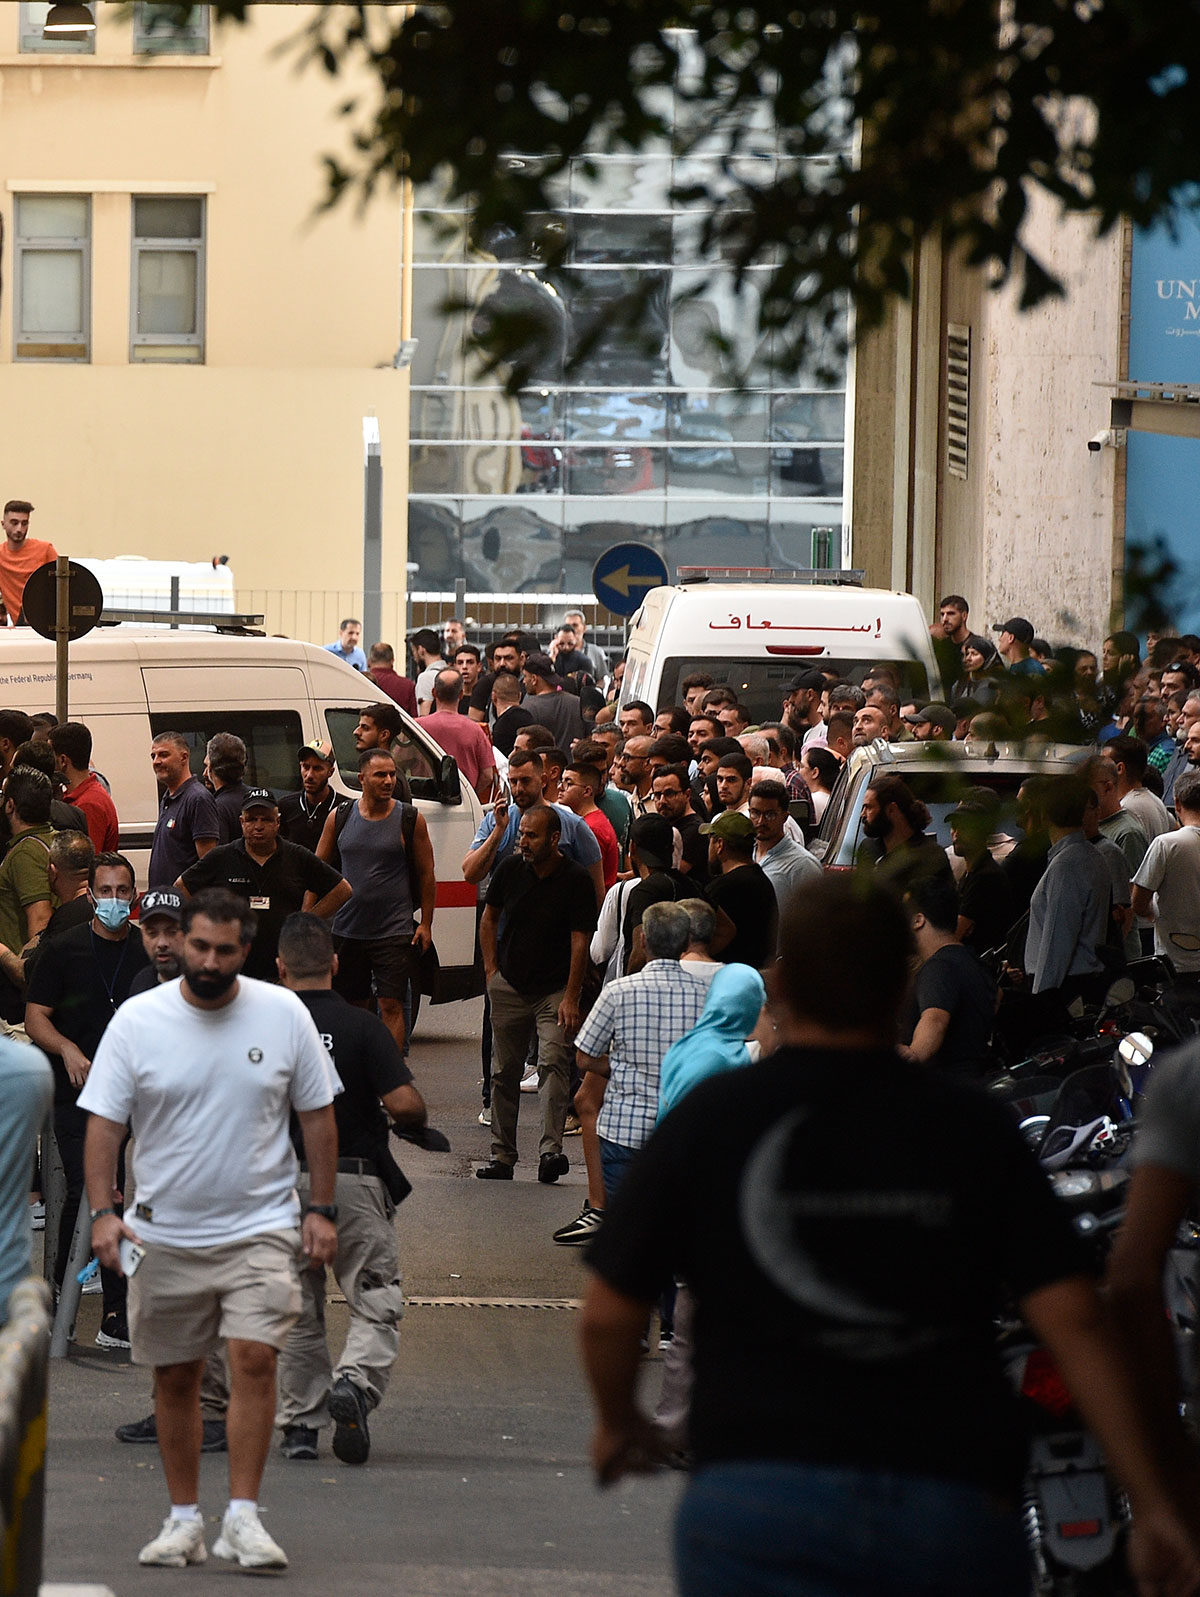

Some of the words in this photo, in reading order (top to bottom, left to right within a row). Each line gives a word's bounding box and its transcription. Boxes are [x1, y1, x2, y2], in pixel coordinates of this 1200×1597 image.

[1156, 279, 1200, 299] UN
[708, 613, 883, 639] إسعاف
[0, 676, 9, 685] the
[10, 674, 32, 684] Federal
[156, 893, 181, 908] AUB
